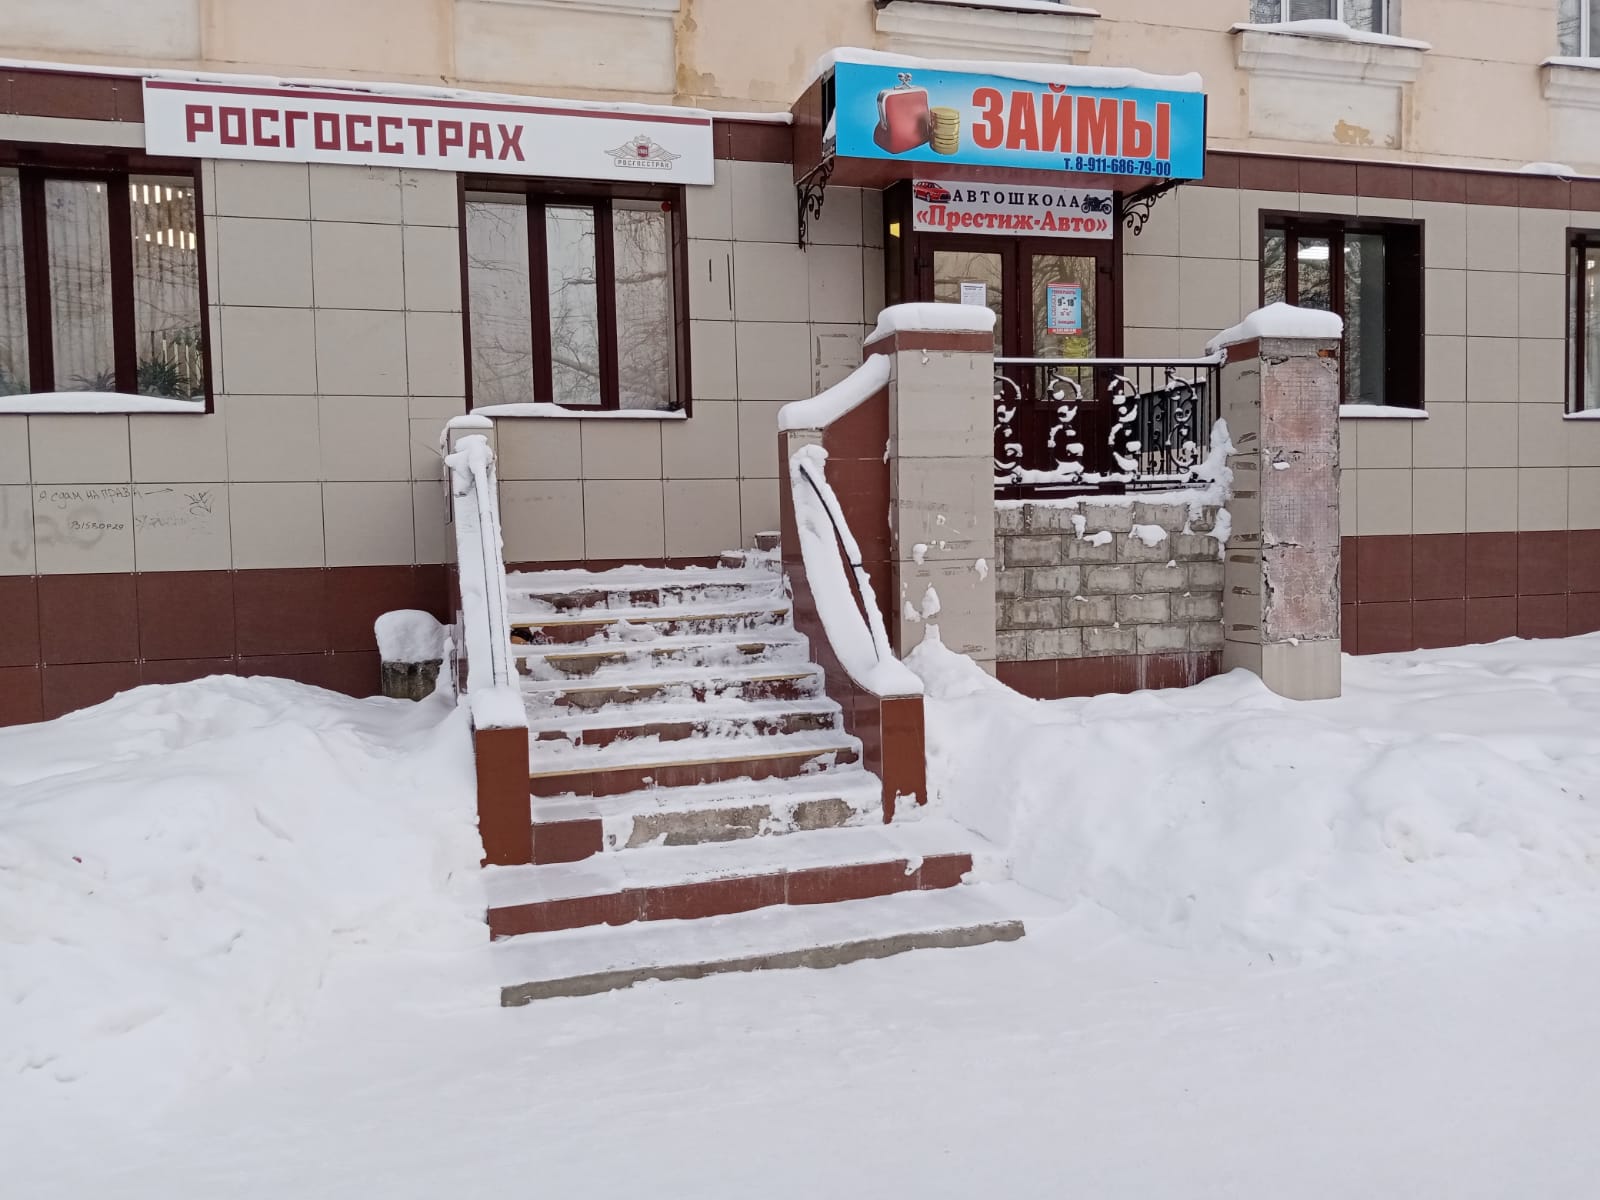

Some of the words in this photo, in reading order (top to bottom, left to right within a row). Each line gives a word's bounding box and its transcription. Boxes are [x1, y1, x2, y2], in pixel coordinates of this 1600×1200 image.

[185, 104, 525, 162] РОСГОССТРАХ
[972, 82, 1170, 159] ЗАЙМЫ
[1076, 156, 1171, 176] 8-911-686-79-00
[952, 188, 1080, 208] АВТОШКОЛА
[916, 205, 1107, 232] «Престиж-Авто»
